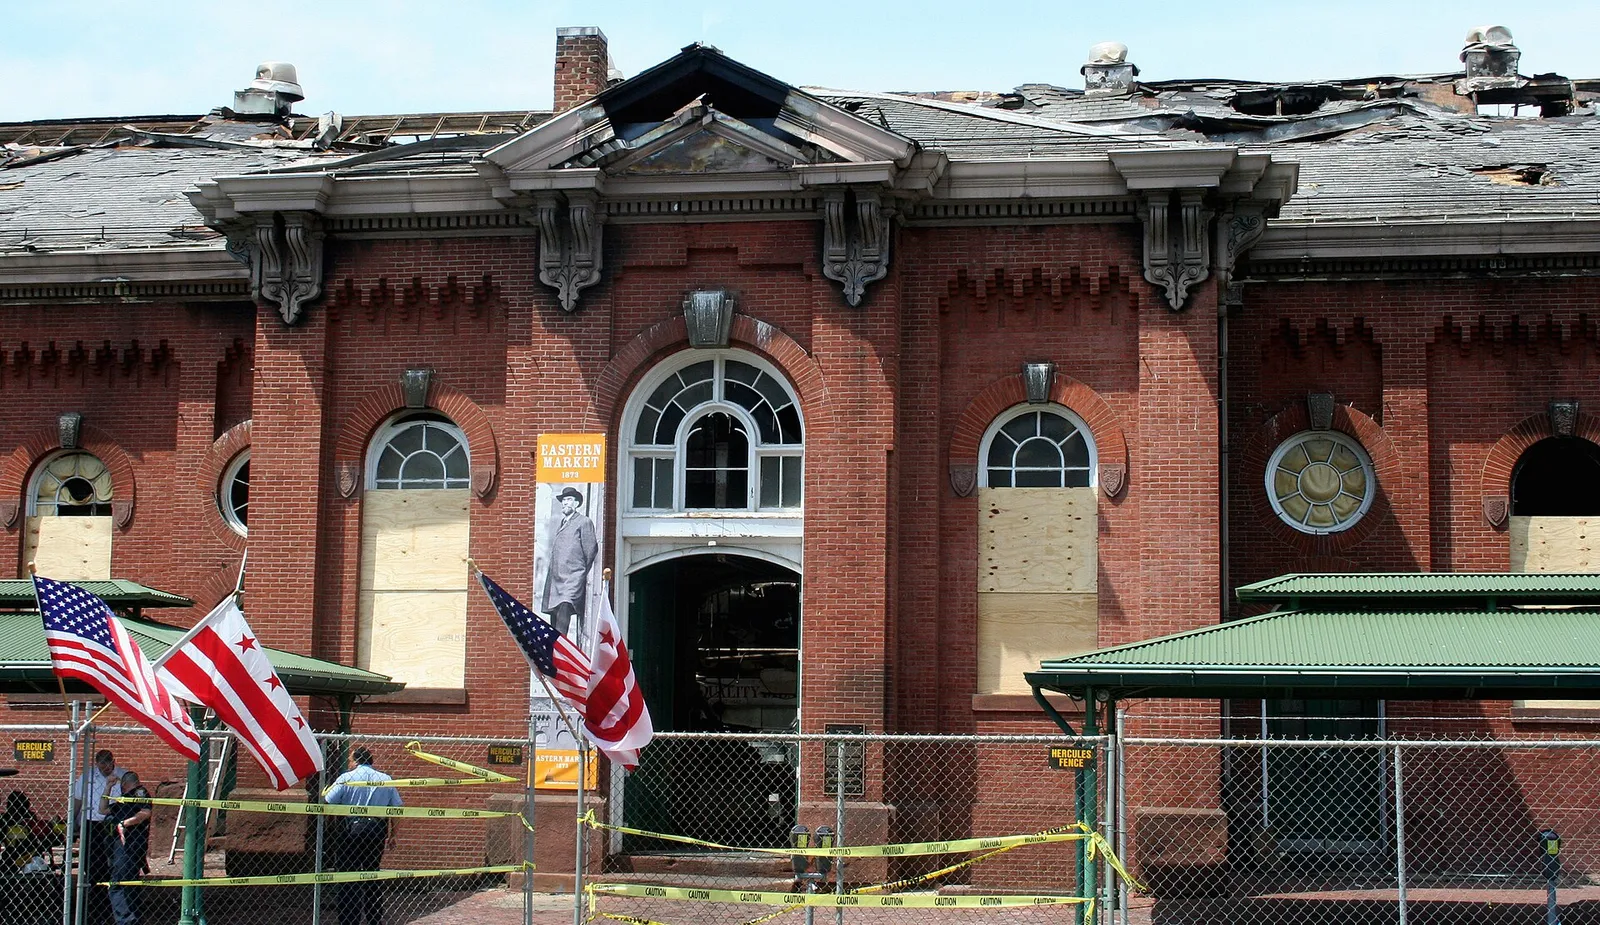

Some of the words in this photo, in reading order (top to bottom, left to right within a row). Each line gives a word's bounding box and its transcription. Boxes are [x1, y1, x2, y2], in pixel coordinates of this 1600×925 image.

[541, 444, 602, 456] EASTERN
[543, 456, 599, 468] MARKET
[561, 471, 579, 479] 1873
[16, 742, 53, 752] HERCULES
[490, 747, 521, 756] HERCULES
[23, 751, 45, 759] FENCE
[1051, 748, 1093, 758] HERCULES
[495, 755, 515, 763] FENCE
[535, 754, 563, 762] ASTERN
[1058, 758, 1084, 767] FENCE
[305, 805, 324, 813] CAUTION
[349, 807, 368, 815] CAUTION
[645, 887, 667, 897] CAUTION
[688, 890, 710, 899] CAUTION
[740, 893, 762, 902] CAUTION
[784, 895, 806, 904] CAUTION
[836, 896, 859, 905] CAUTION
[881, 897, 903, 905] CAUTION
[934, 897, 957, 906] CAUTION
[979, 897, 1002, 906] CAUTION
